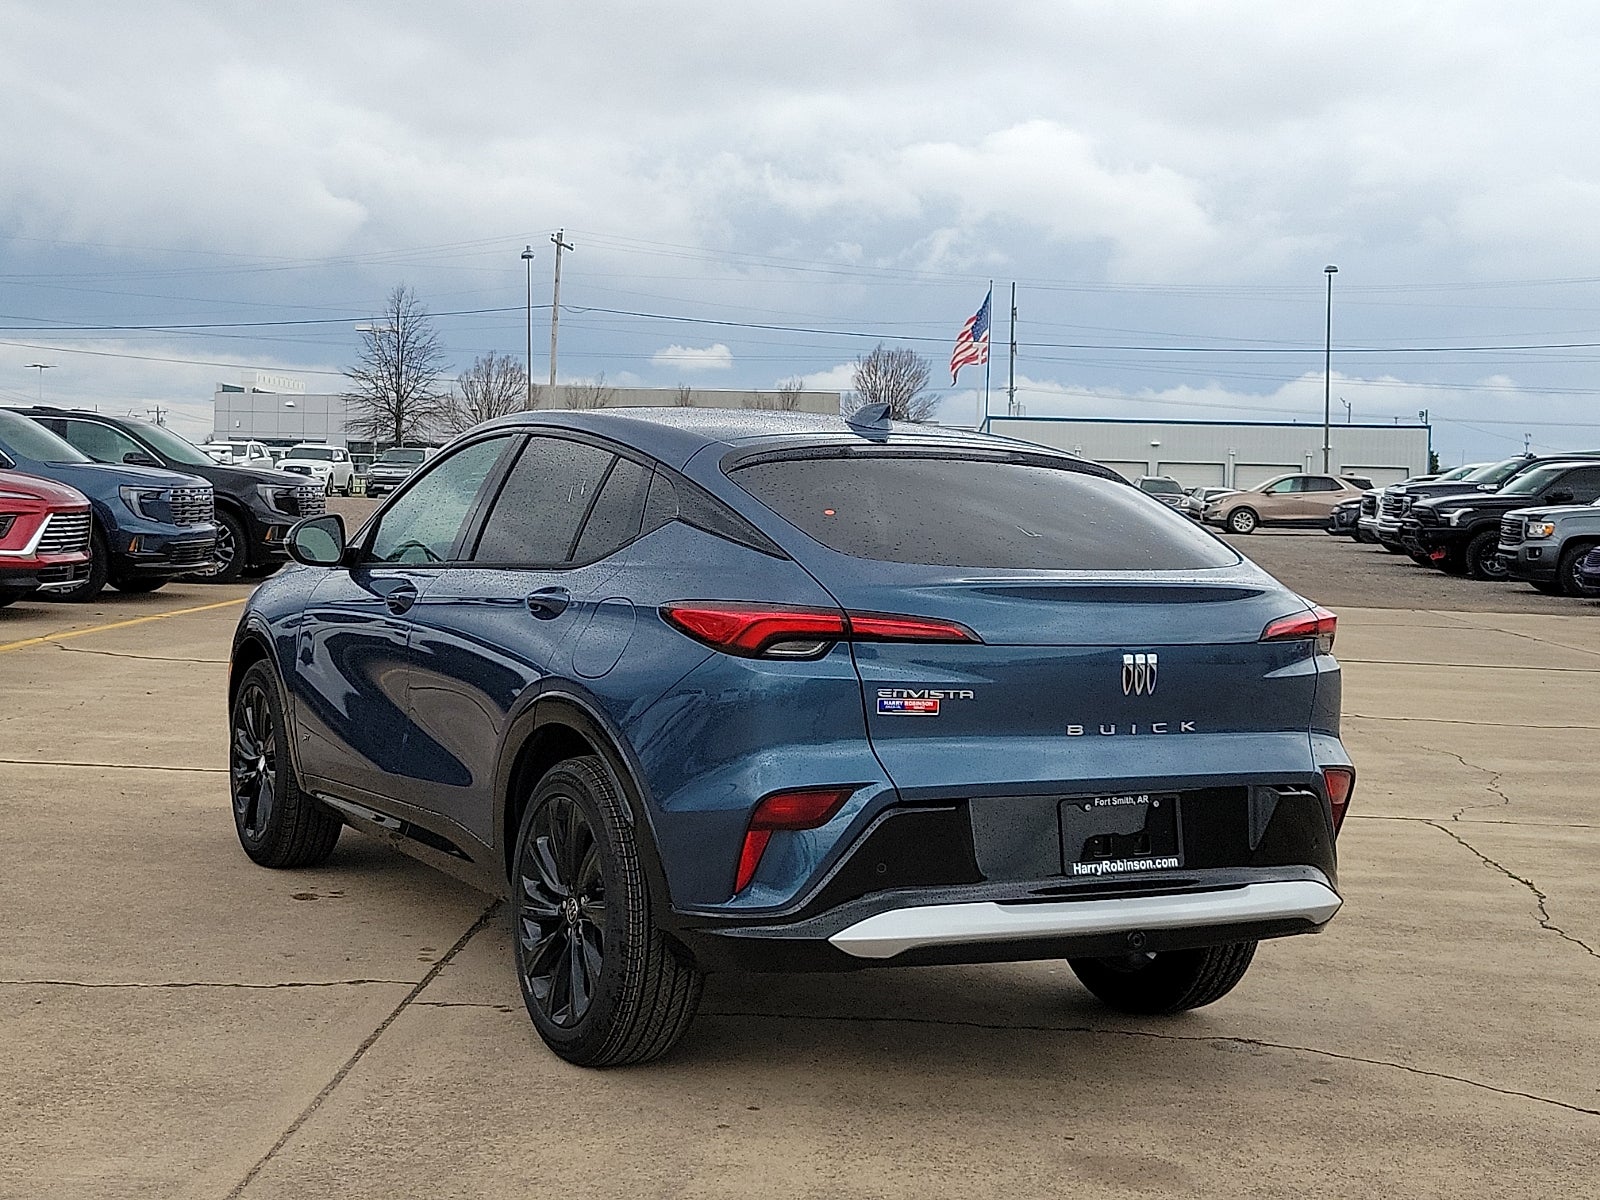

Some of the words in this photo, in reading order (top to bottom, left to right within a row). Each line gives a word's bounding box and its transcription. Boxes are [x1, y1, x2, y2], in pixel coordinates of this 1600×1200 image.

[877, 688, 975, 700] ENVISTA
[1066, 720, 1197, 736] BUICK
[1094, 797, 1111, 807] Fort
[1112, 795, 1136, 806] Smith,
[1137, 794, 1149, 804] AR
[1072, 857, 1179, 875] HarryRobinson.com
